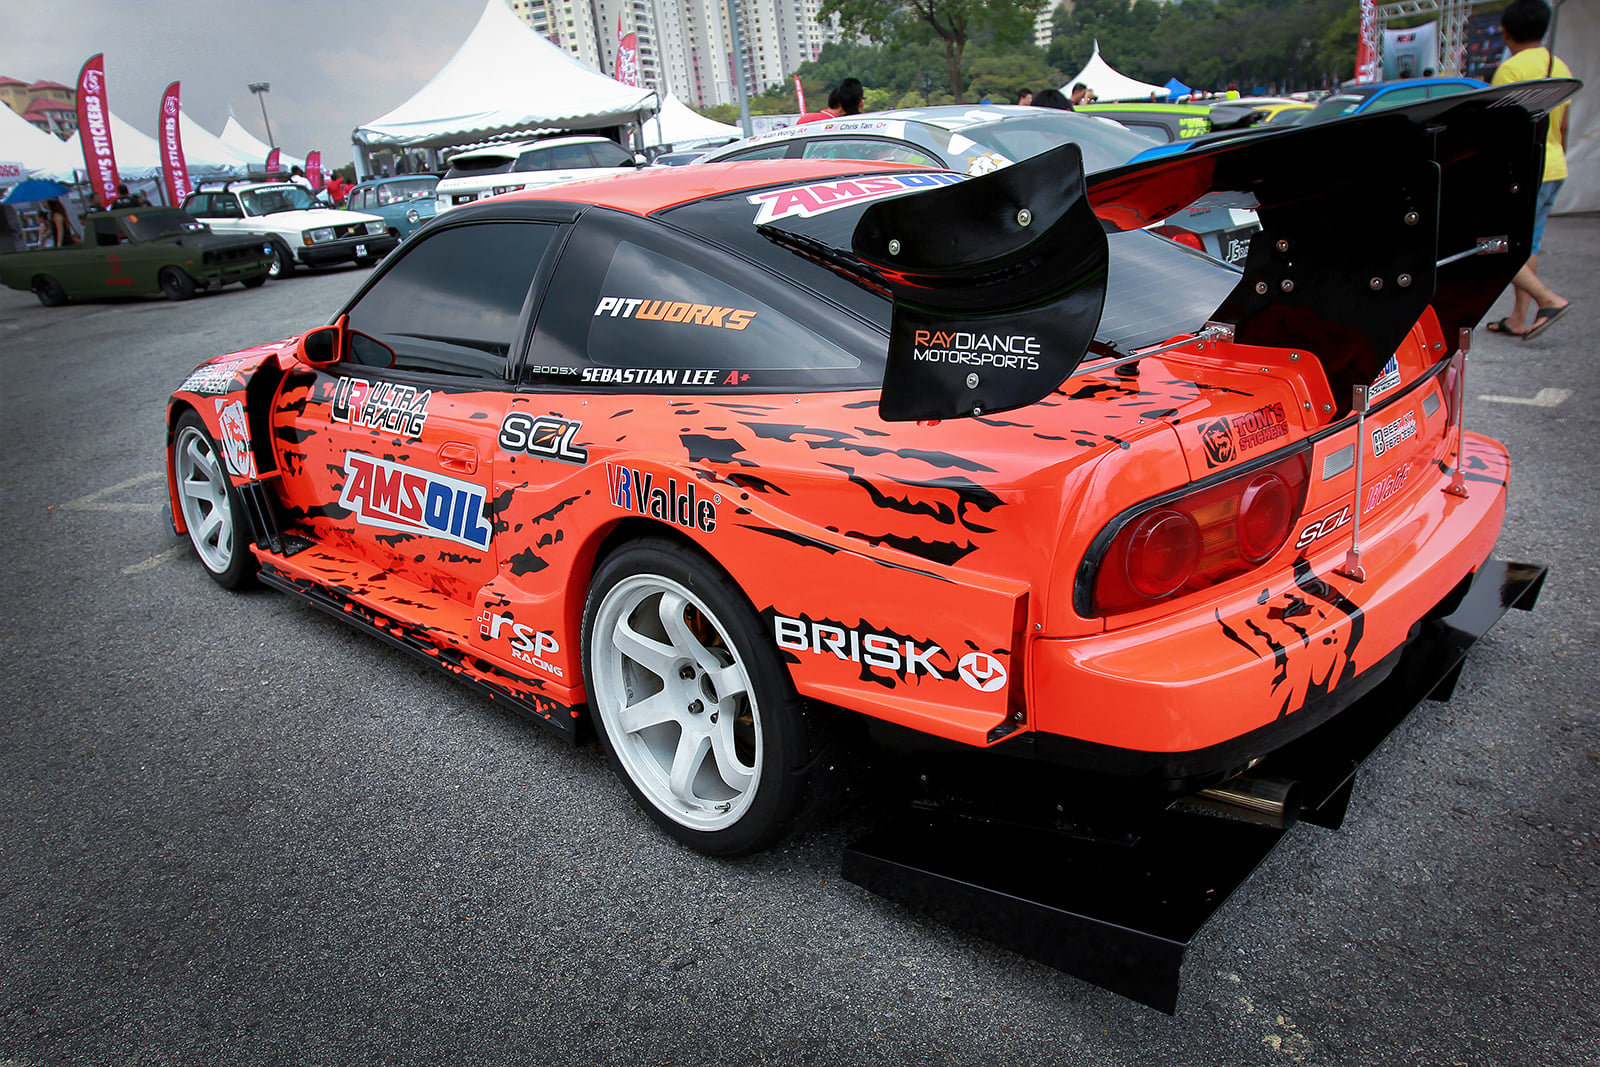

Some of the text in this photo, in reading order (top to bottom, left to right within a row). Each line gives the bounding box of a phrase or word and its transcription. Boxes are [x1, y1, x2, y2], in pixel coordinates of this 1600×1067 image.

[86, 95, 111, 156] STICKERS
[594, 296, 757, 331] PITWORKS
[913, 348, 1040, 370] MOTORSPORTS
[914, 330, 1041, 355] RAYDIANCE
[532, 365, 578, 376] 200SX
[581, 367, 677, 385] SEBASTIAN
[681, 369, 720, 385] LEE
[369, 382, 432, 413] ULTRA
[361, 402, 428, 438] RACING
[1232, 402, 1287, 437] TOM'S
[1239, 421, 1290, 452] STICKERS
[346, 457, 488, 547] AMSOIL
[511, 647, 564, 678] RACING
[774, 615, 945, 680] BRISK
